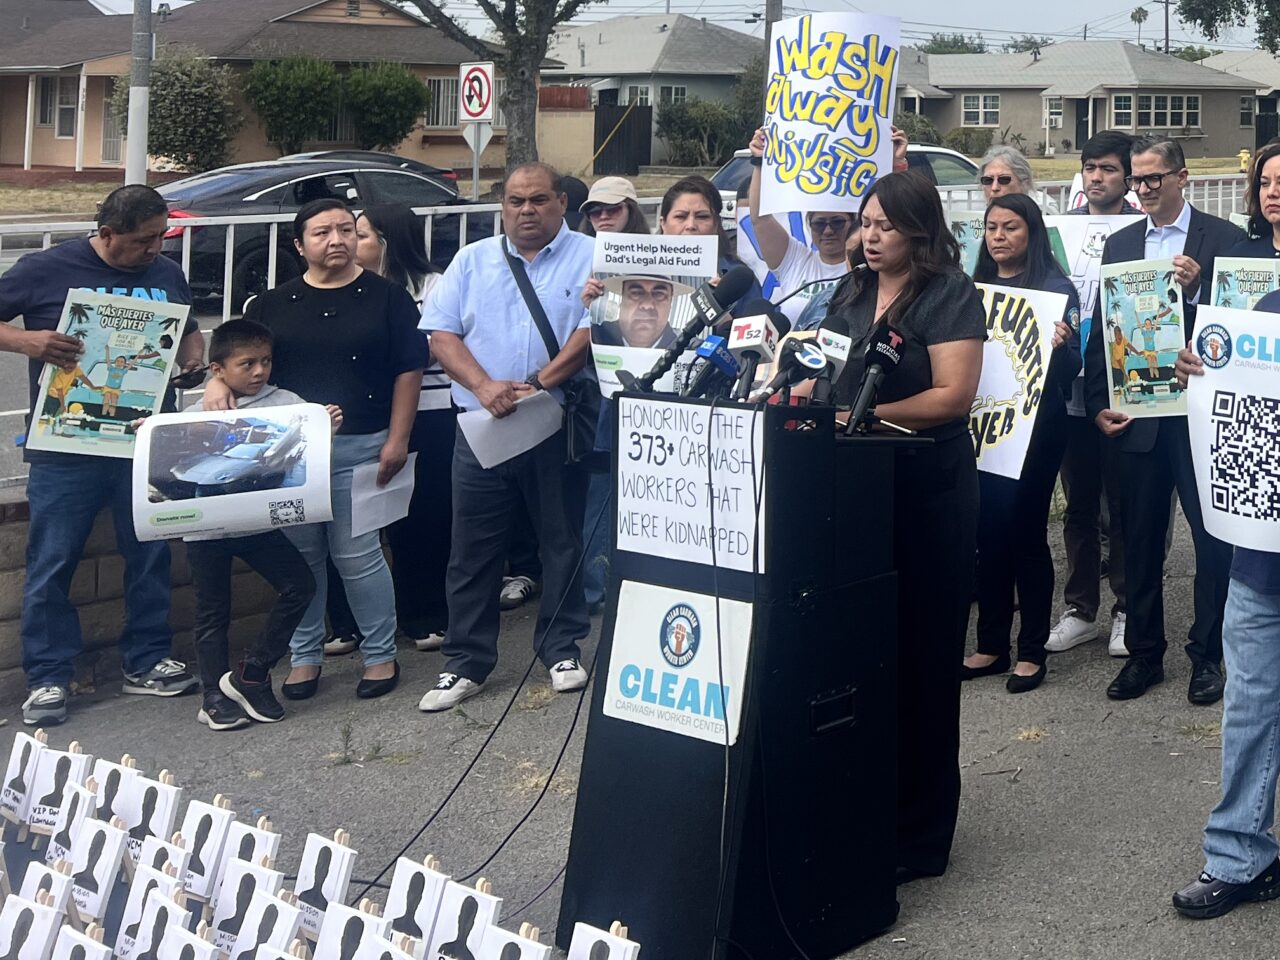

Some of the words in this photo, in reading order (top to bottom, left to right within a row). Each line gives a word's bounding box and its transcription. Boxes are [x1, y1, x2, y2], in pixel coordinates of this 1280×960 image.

[604, 242, 635, 253] Urgent
[636, 244, 659, 254] Help
[660, 245, 703, 254] Needed:
[605, 254, 631, 264] Dad's
[632, 255, 657, 266] Legal
[658, 256, 675, 265] Aid
[676, 257, 701, 266] Fund
[1132, 269, 1158, 282] FUERTES
[1247, 270, 1274, 283] FUERTES
[1125, 282, 1138, 295] QUE
[1137, 280, 1155, 295] AYER
[1238, 281, 1252, 294] QUE
[1250, 282, 1270, 294] AYER
[97, 304, 117, 317] MÁS
[117, 306, 155, 321] FUERTES
[100, 316, 122, 330] QUE
[120, 318, 145, 331] AYER
[745, 329, 762, 340] 52
[832, 341, 847, 352] 34
[1234, 359, 1272, 371] CARWASH
[621, 401, 704, 435] HONORING
[711, 413, 744, 439] THE
[971, 406, 1016, 458] YER
[628, 431, 675, 466] 373+
[679, 435, 754, 477] CARWASH
[621, 471, 697, 508] WORKERS
[704, 482, 743, 513] THAT
[619, 510, 659, 538] WERE
[665, 516, 749, 556] KIDNAPPED
[618, 663, 731, 721] CLEAN
[615, 699, 655, 717] CARWASH
[656, 712, 692, 728] WORKER
[693, 719, 726, 734] CENTER
